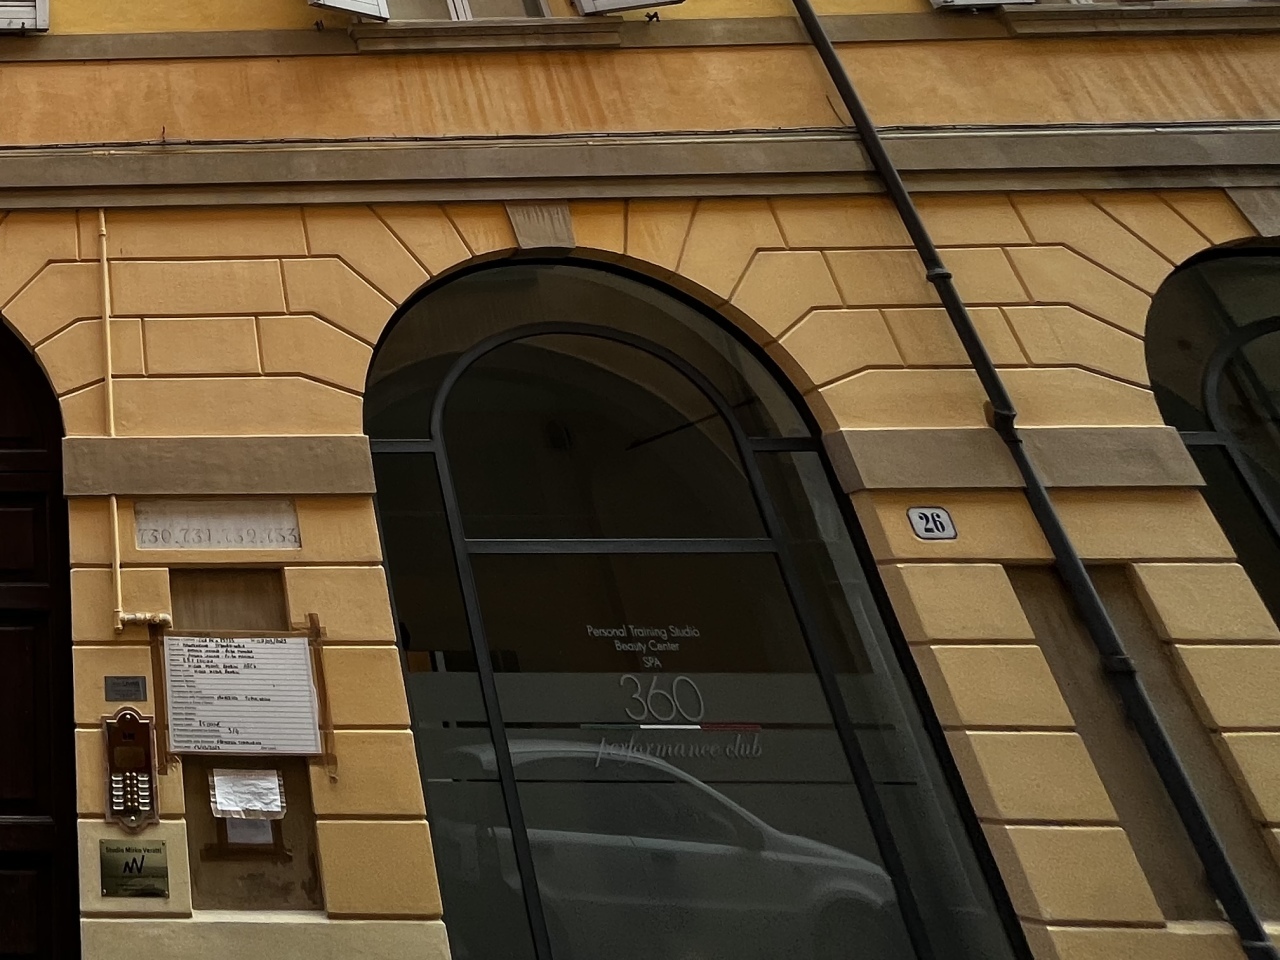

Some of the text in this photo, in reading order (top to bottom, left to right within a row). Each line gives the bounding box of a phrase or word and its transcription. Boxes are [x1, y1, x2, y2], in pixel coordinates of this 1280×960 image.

[918, 512, 946, 533] 26
[586, 625, 700, 640] Personal Training Studio
[614, 640, 680, 654] Beauty Center
[642, 657, 662, 668] SPA
[620, 674, 704, 722] 360
[595, 732, 762, 768] performance club
